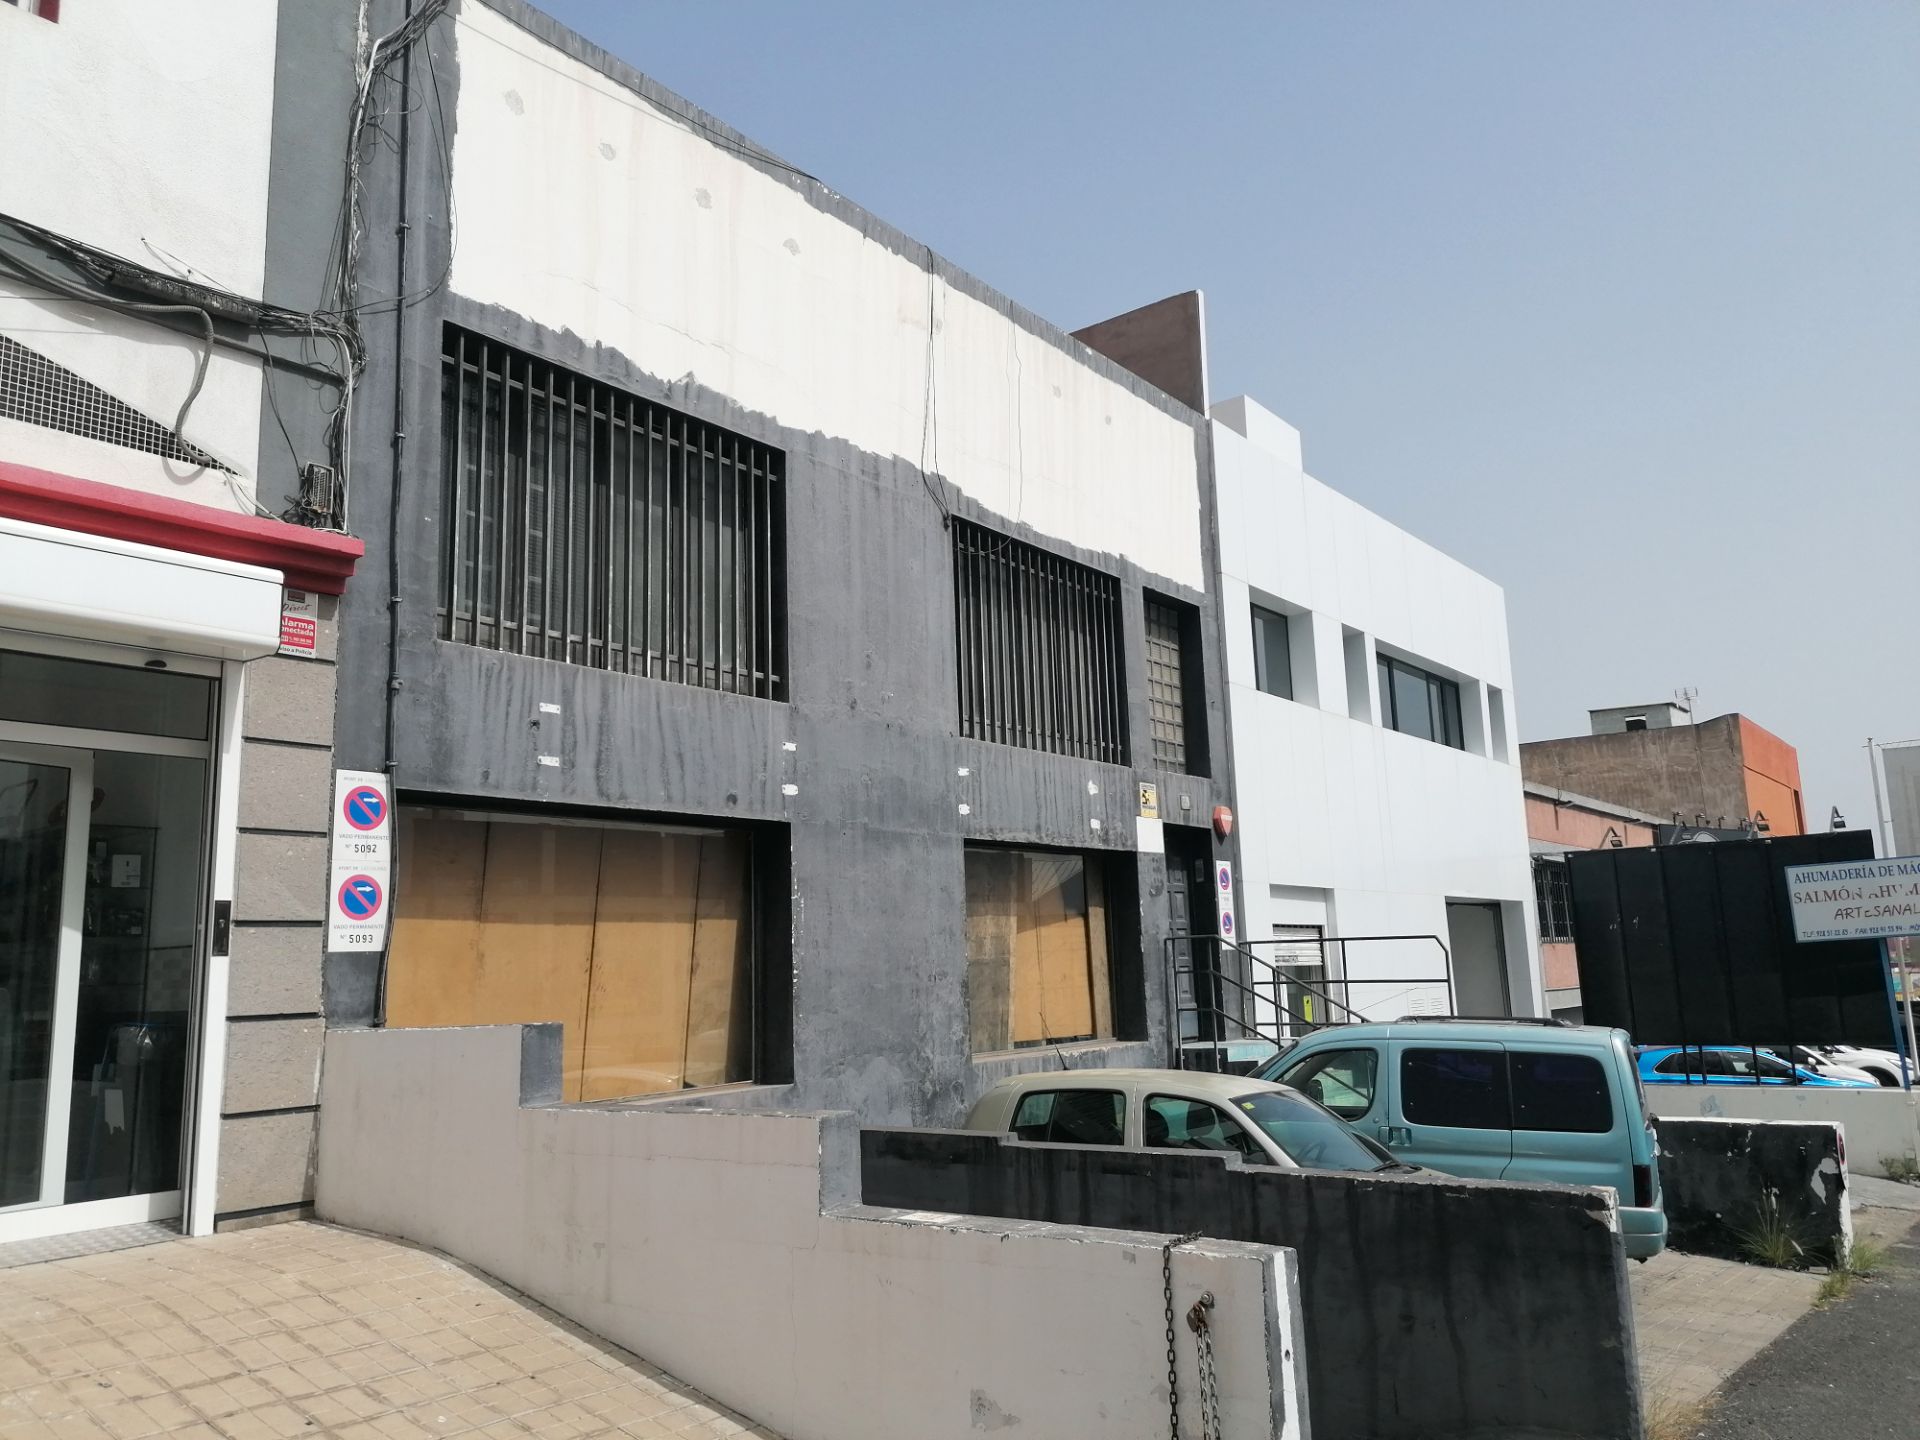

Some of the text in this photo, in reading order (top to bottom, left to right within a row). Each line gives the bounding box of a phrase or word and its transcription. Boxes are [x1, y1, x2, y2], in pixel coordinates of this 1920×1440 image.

[354, 844, 377, 853] 5092
[1794, 865, 1876, 884] AHUMADERÍA
[1878, 865, 1895, 878] DE
[1793, 885, 1862, 904] SALMÓN
[349, 934, 373, 943] 5093
